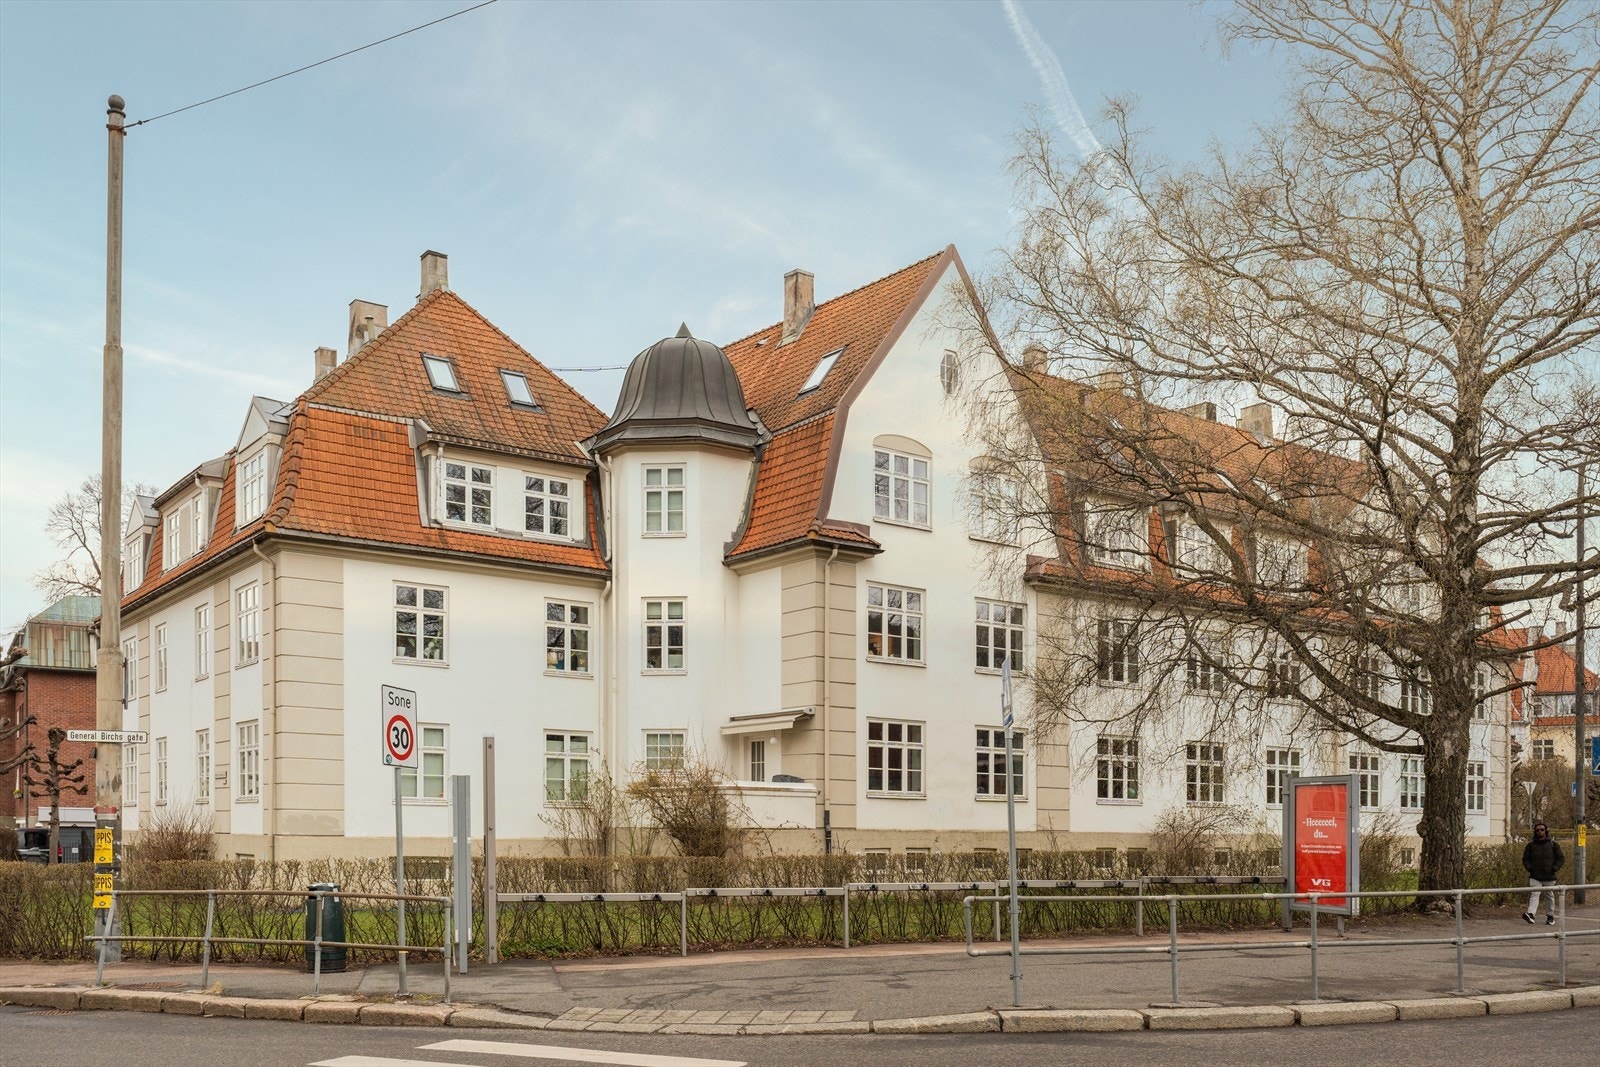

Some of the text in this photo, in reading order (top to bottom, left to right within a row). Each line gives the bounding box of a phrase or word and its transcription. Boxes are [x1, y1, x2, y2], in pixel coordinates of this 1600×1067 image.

[388, 691, 411, 709] Sone
[70, 731, 143, 743] General Birchs gate
[392, 726, 409, 750] 30
[1311, 878, 1331, 887] VG
